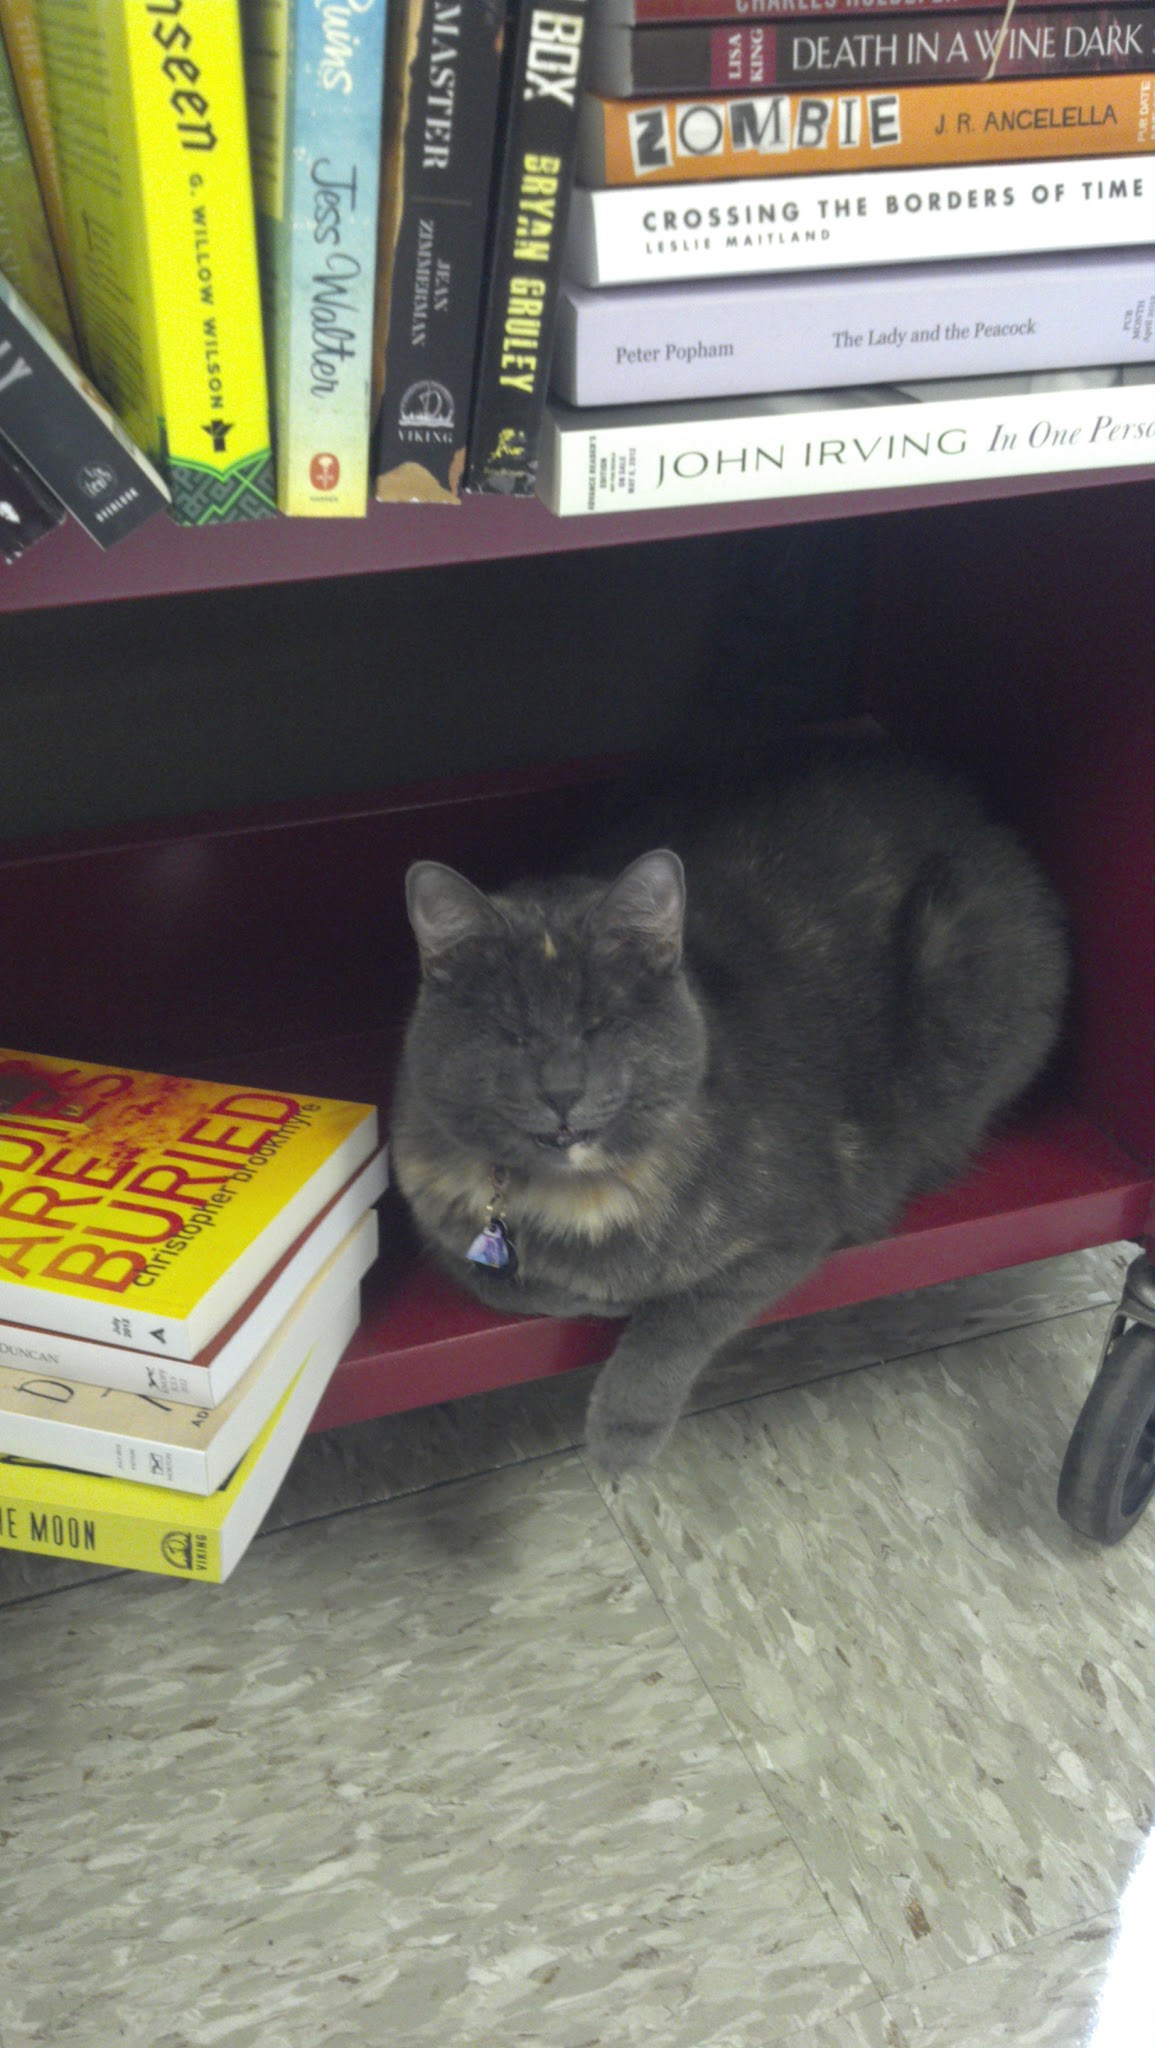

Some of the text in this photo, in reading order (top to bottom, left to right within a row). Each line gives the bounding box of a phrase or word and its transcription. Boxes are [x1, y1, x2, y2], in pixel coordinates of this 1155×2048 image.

[522, 9, 585, 109] BOX
[728, 33, 742, 80] LISA
[750, 28, 763, 82] KING
[792, 24, 1144, 71] DEATH IN A WINE DARK
[422, 0, 462, 170] MASTER
[1139, 80, 1151, 116] DATE
[634, 95, 899, 168] ZOMBIE
[984, 104, 1118, 132] ANCELELLA
[642, 178, 1144, 232] CROSSING THE BORDERS OF TIME
[646, 229, 831, 254] LESLIE MAITLAND
[189, 173, 225, 410] G. WILLOW WILSON
[309, 157, 362, 400] Jess Walter
[411, 218, 435, 347] ZIMMERMAN
[434, 258, 451, 313] JEAN
[499, 153, 562, 393] BRYAN GRULEY
[615, 341, 735, 365] Peter Popham
[832, 318, 1037, 349] The Lady and the Peacock
[398, 429, 453, 444] VIKING
[656, 445, 785, 490] JOHN
[804, 428, 968, 468] IRVING
[987, 424, 1018, 453] In
[1028, 420, 1082, 450] One
[41, 1092, 301, 1294] BURIED
[131, 1101, 322, 1288] christopher brookmyre
[0, 1342, 60, 1365] DUNCAN
[30, 1510, 97, 1551] MOON
[194, 1534, 208, 1571] VIKING
